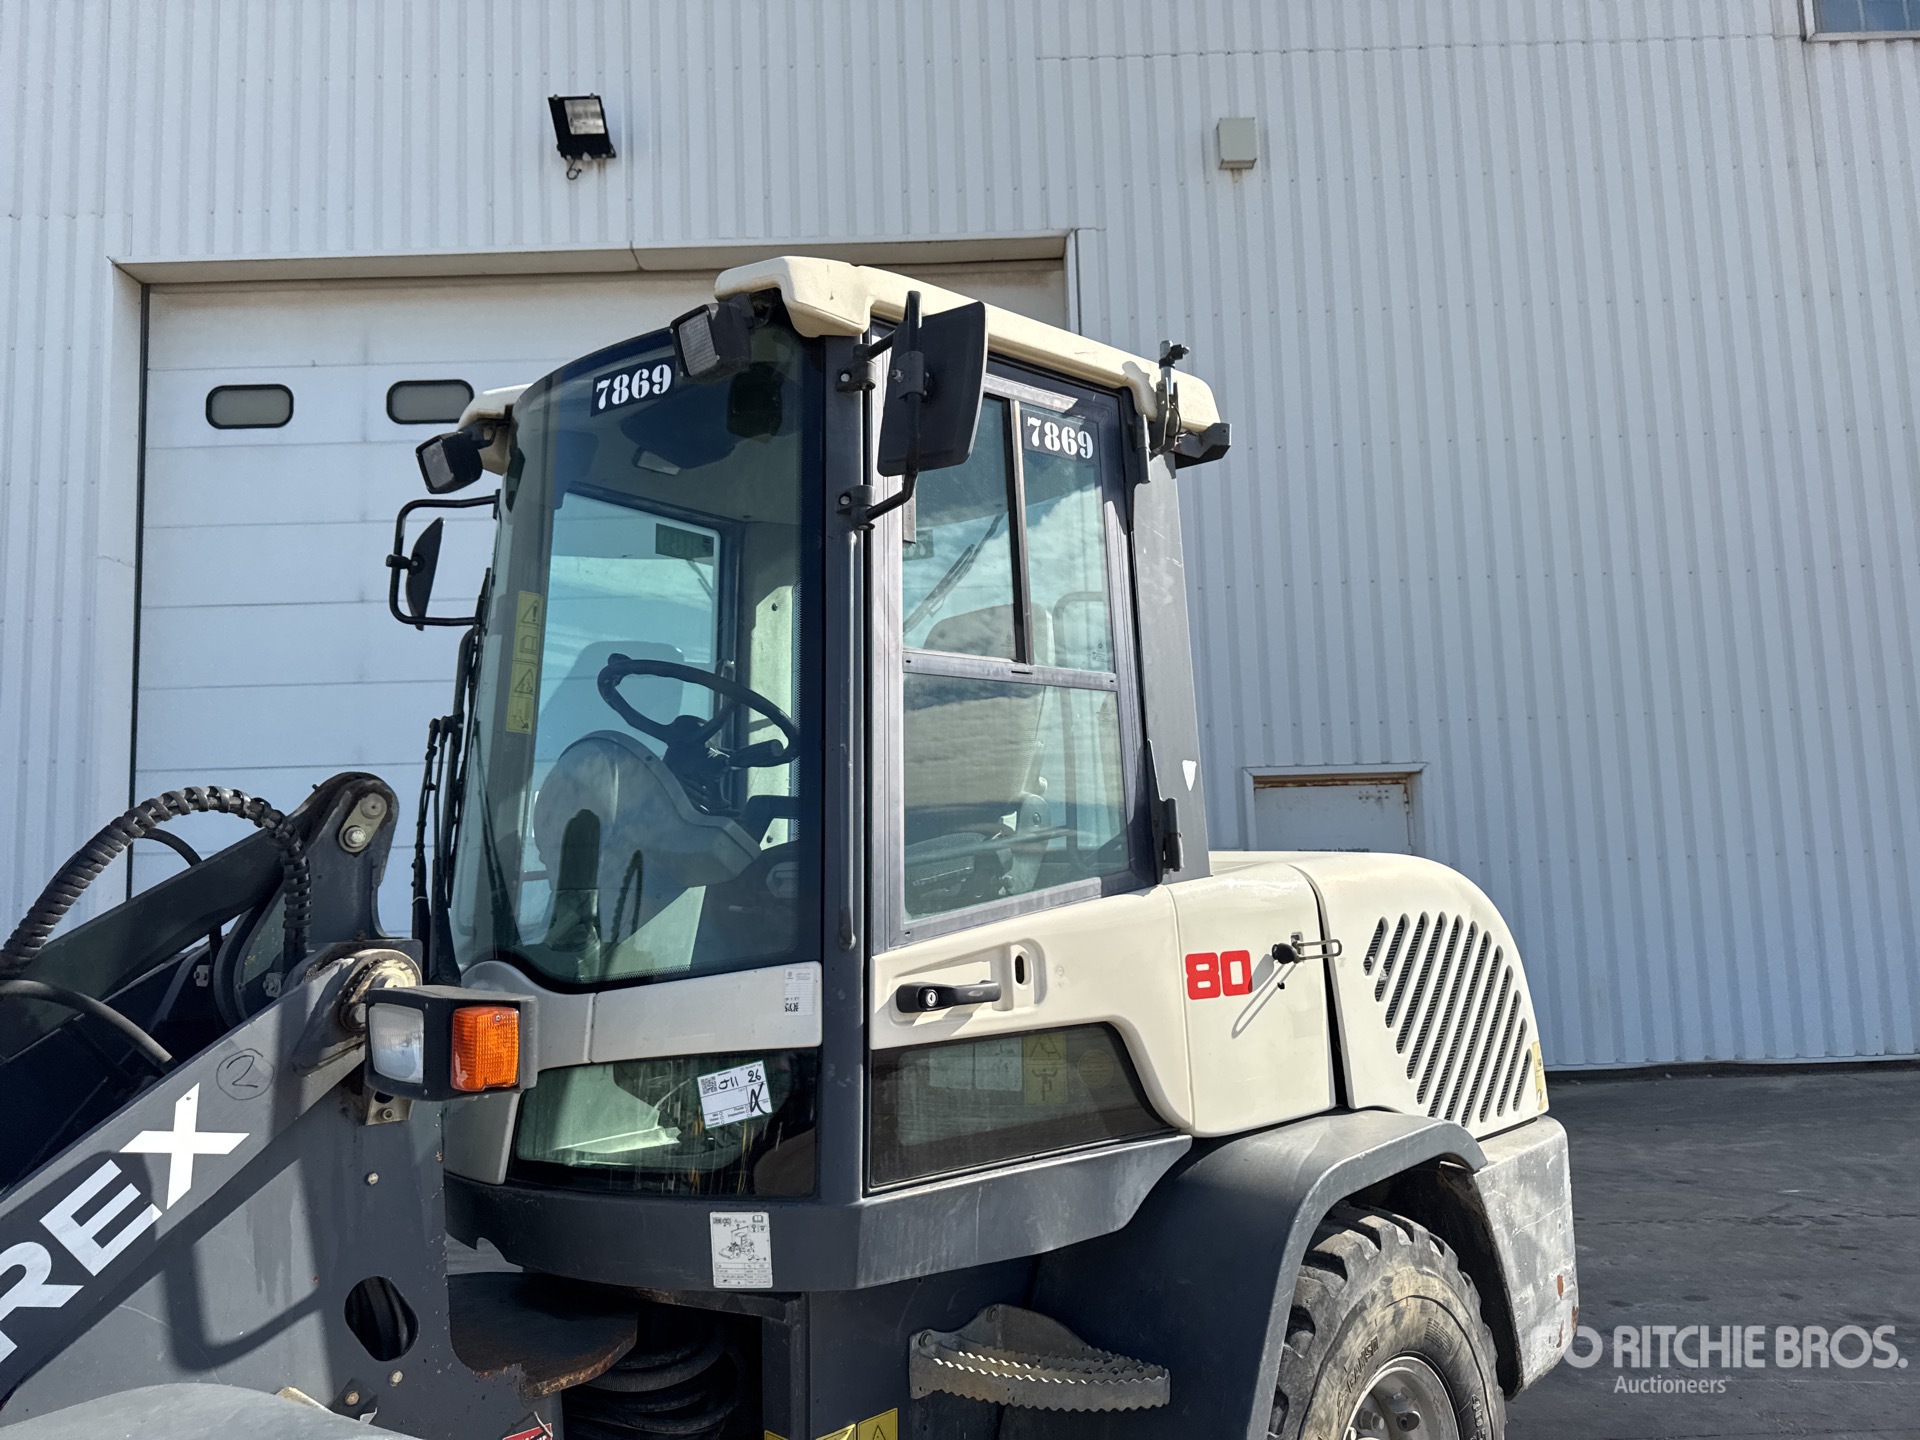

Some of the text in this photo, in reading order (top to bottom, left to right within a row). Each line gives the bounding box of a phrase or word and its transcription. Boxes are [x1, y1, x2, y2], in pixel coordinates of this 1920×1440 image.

[596, 364, 672, 410] 7869
[1027, 416, 1094, 459] 7869
[1185, 949, 1252, 1000] 80
[226, 1054, 259, 1088] 2
[0, 1082, 250, 1363] REX
